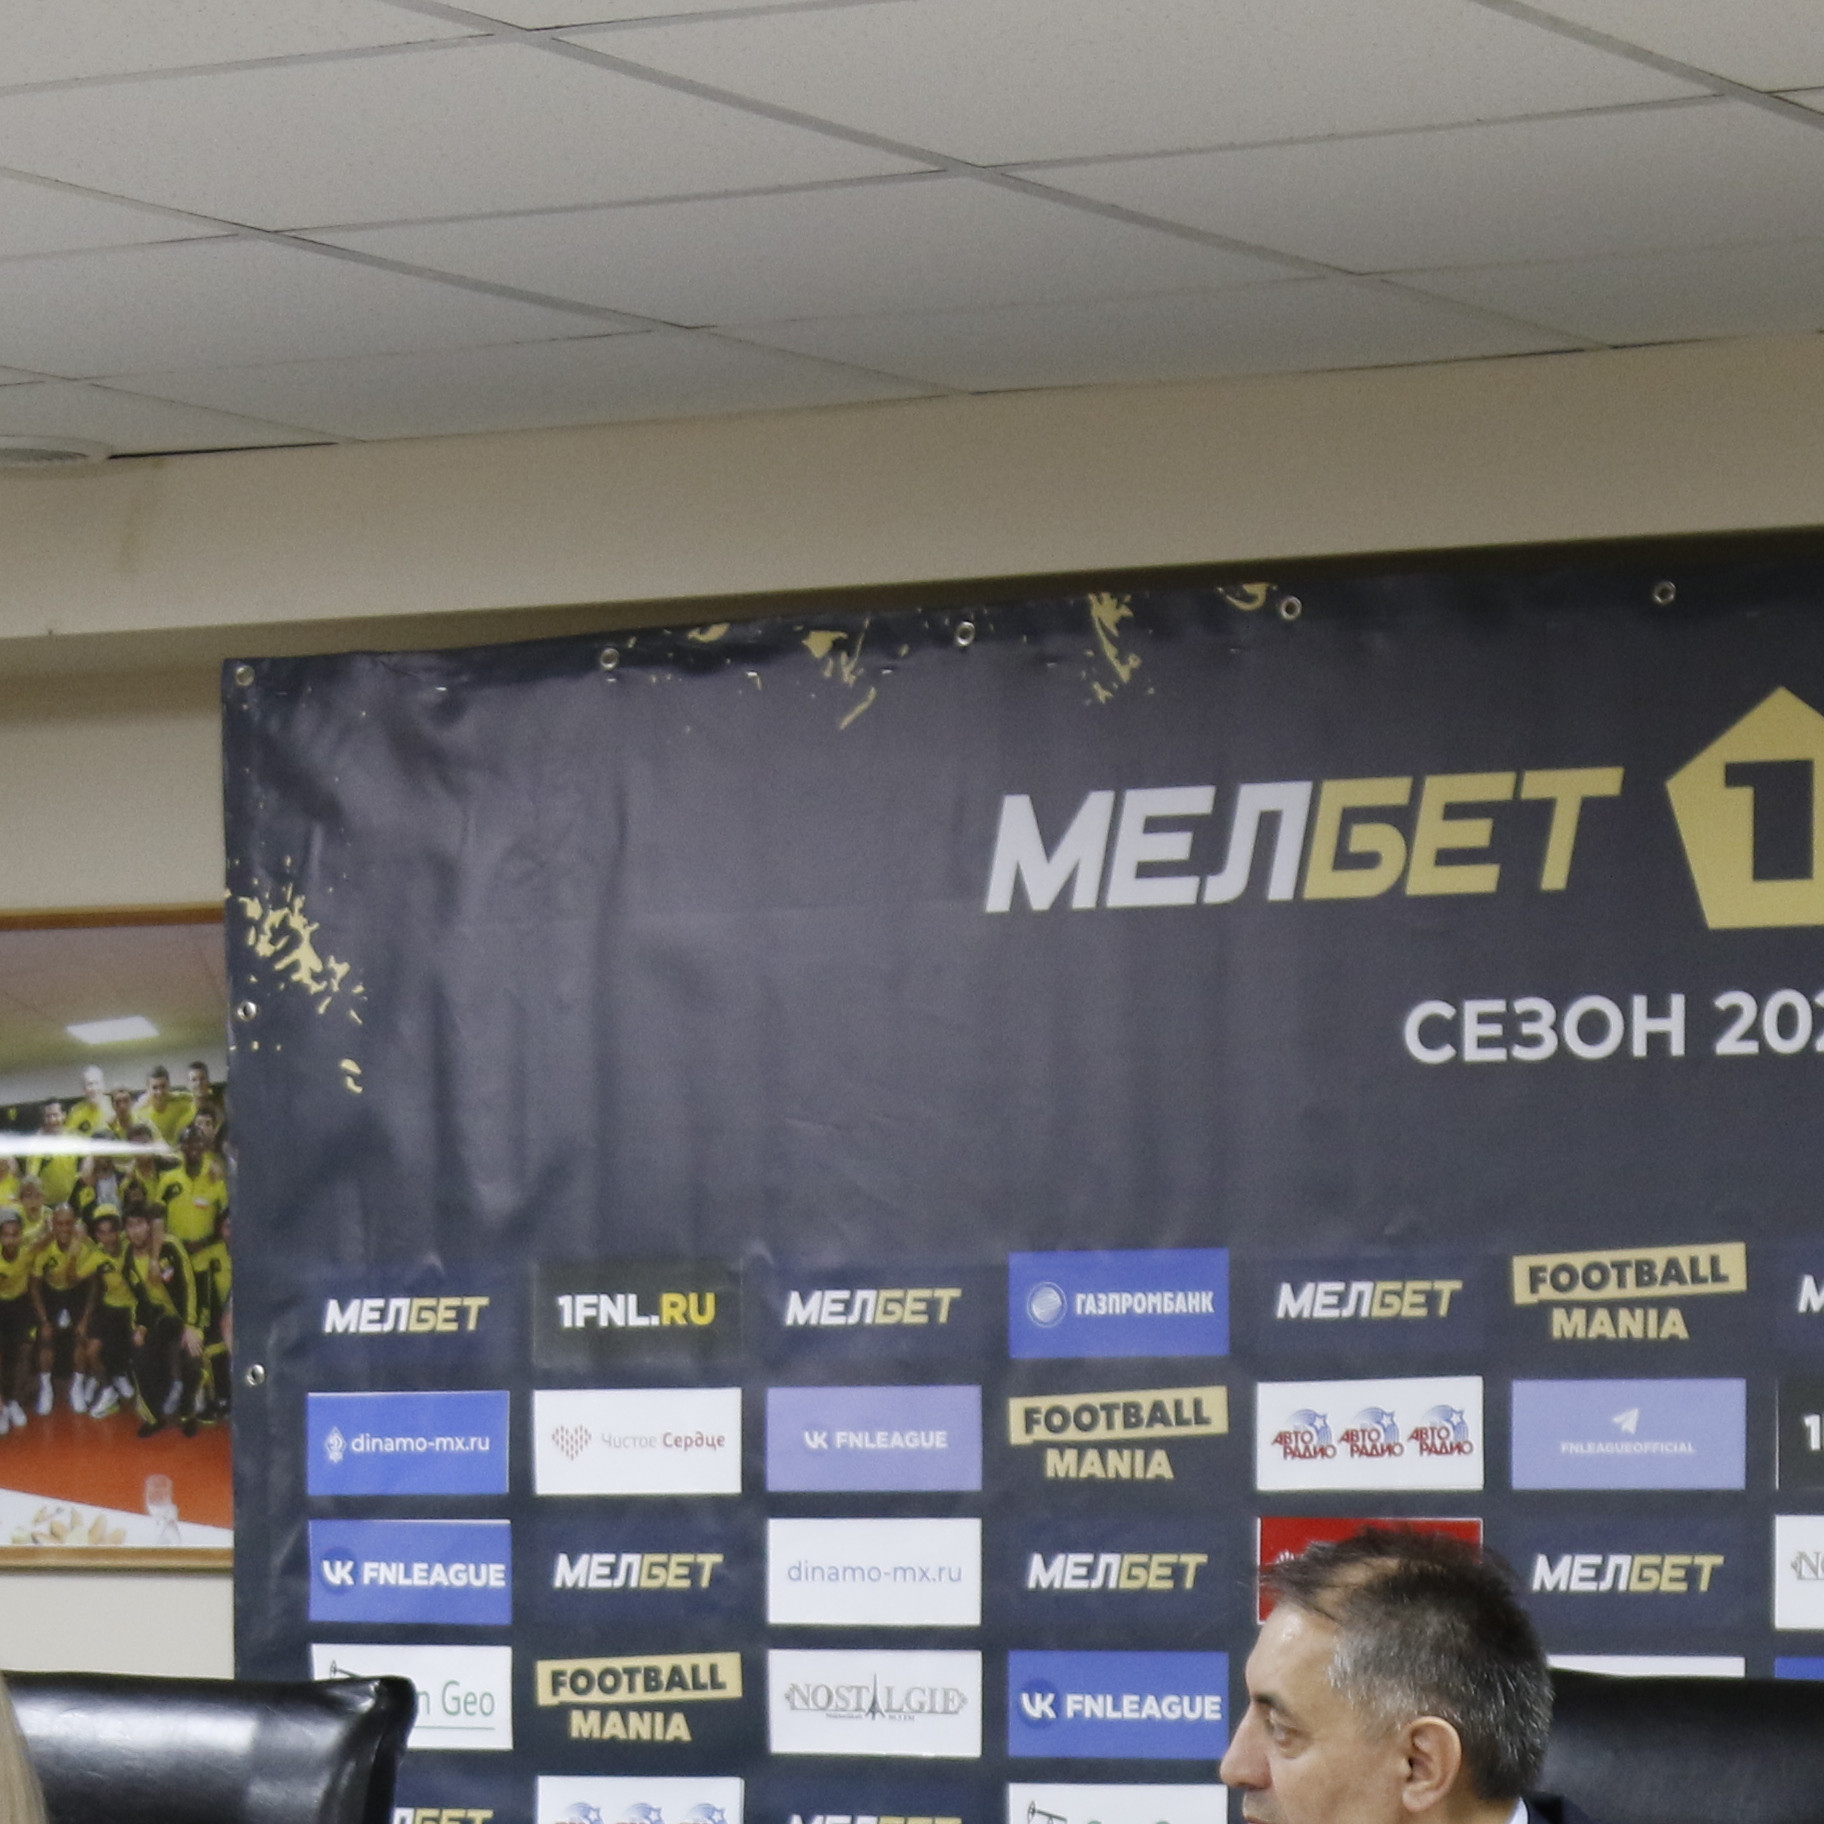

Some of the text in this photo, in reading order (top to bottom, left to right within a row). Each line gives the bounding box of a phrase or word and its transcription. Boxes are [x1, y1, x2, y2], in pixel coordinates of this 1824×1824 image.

[984, 766, 1623, 913] МЕЛБЕТ
[1722, 759, 1814, 882] 1
[1404, 995, 1686, 1066] СЕЗОН
[1528, 1255, 1729, 1294] FOOTBALL
[325, 1296, 488, 1333] МЕЛБЕТ
[558, 1292, 715, 1328] 1FNL.RU
[785, 1288, 961, 1326] МЕЛБЕТ
[1075, 1291, 1214, 1314] ГАЗПРОМБАНК
[1277, 1280, 1462, 1318] МЕЛБЕТ
[1552, 1307, 1689, 1339] MANIA
[1023, 1398, 1211, 1434] FOOTBALL
[351, 1432, 490, 1454] dinamo-mx.ru
[662, 1431, 726, 1451] Сердце
[835, 1431, 947, 1449] FNLEAGUE
[1271, 1431, 1313, 1445] АВТО
[1339, 1428, 1381, 1443] АВТО
[1407, 1426, 1450, 1441] АВТО
[1419, 1441, 1474, 1457] РАДИО
[1045, 1447, 1174, 1480] MANIA
[1283, 1444, 1337, 1460] РАДИО
[1350, 1442, 1404, 1458] РАДИО
[363, 1562, 505, 1587] FNLEAGUE
[553, 1553, 723, 1589] МЕЛБЕТ
[787, 1559, 962, 1584] dinamo-mx.ru
[1028, 1553, 1208, 1590] МЕЛБЕТ
[1532, 1554, 1724, 1593] МЕЛБЕТ
[550, 1662, 727, 1696] FOOTBALL
[441, 1681, 495, 1717] Geo
[1067, 1695, 1222, 1721] FNLEAGUE
[570, 1712, 691, 1742] MANIA
